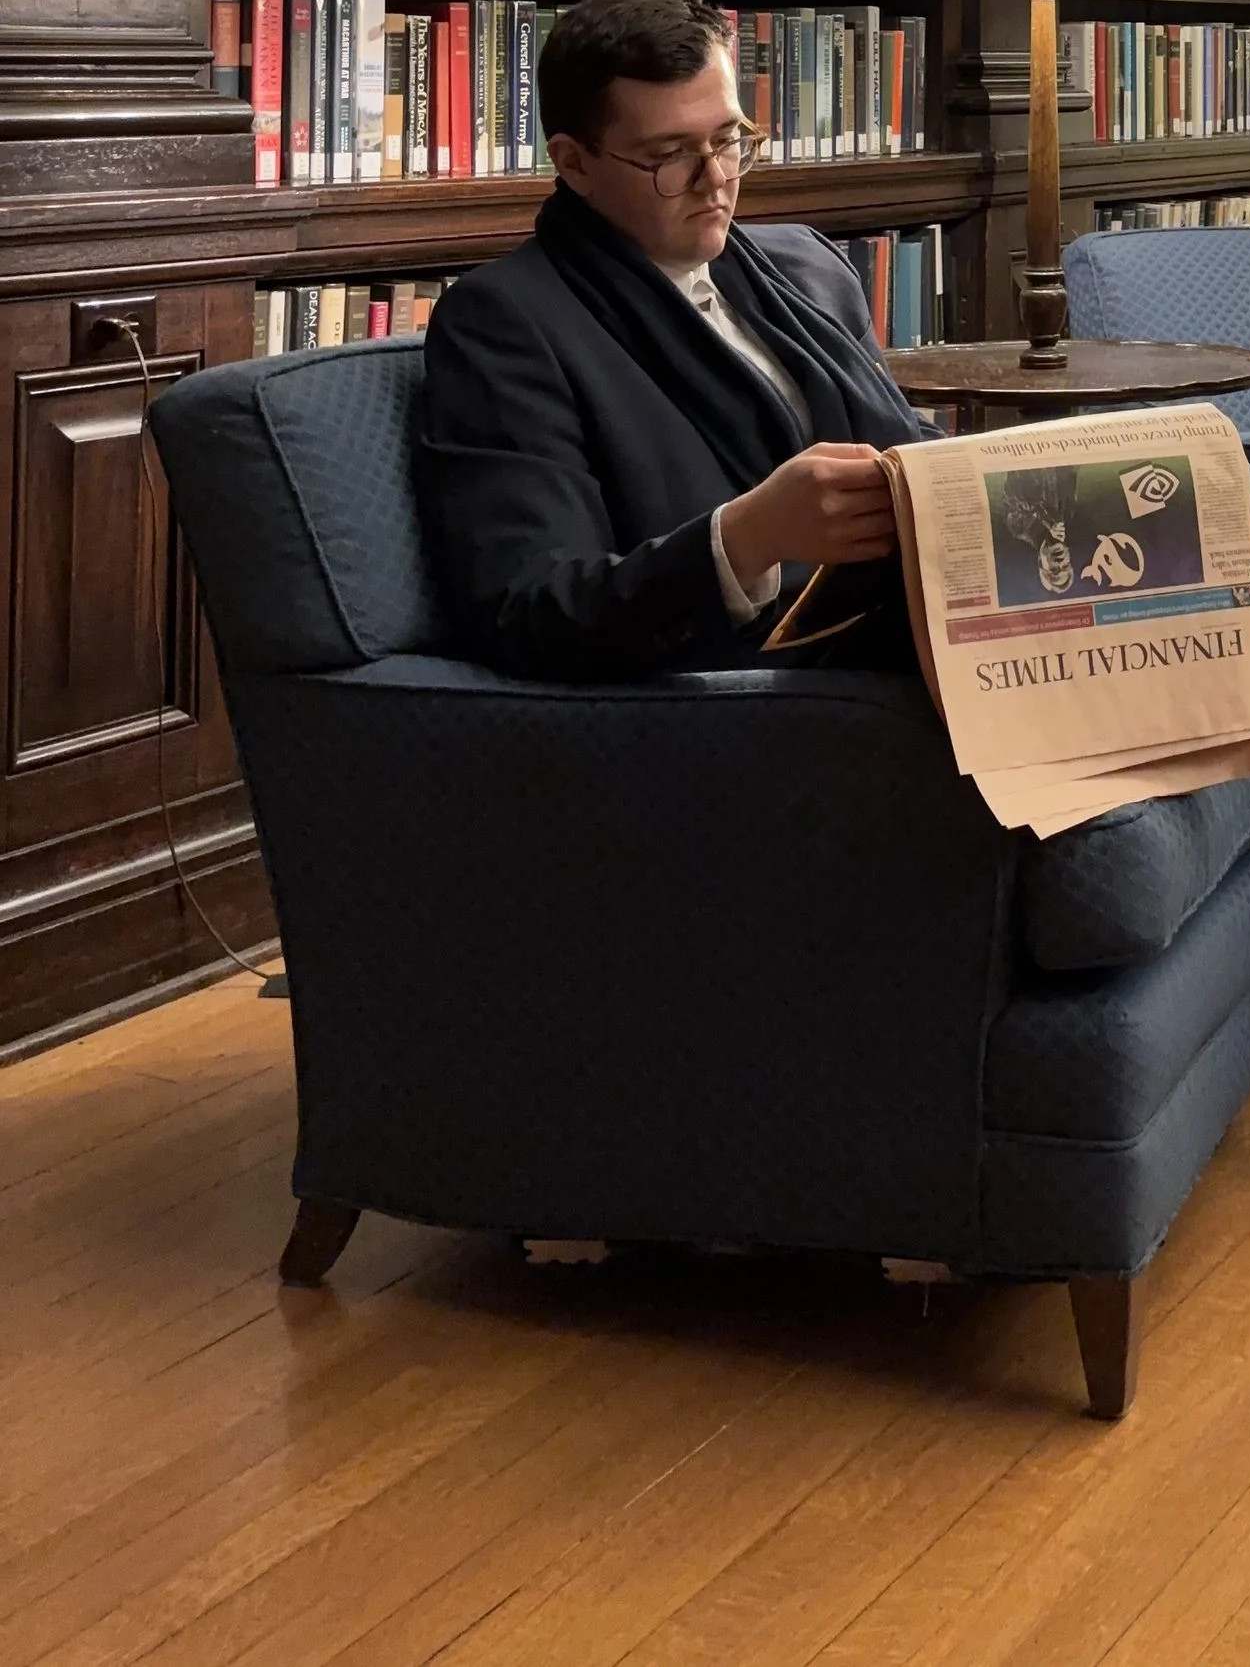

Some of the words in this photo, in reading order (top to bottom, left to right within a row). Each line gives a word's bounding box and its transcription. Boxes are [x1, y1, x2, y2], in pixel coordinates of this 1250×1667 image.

[417, 21, 428, 45] The
[341, 19, 350, 68] MACARTHUR
[519, 22, 531, 69] General
[417, 46, 428, 80] Years
[341, 69, 349, 80] AT
[519, 71, 530, 84] of
[341, 81, 349, 99] WAR
[417, 83, 428, 97] of
[519, 86, 530, 106] the
[417, 99, 427, 147] MacAr
[516, 108, 529, 144] Army
[308, 290, 318, 327] DEAN
[1161, 413, 1208, 426] federal
[1121, 432, 1139, 443] on
[1141, 429, 1183, 442] freeze
[1183, 424, 1232, 438] Trump
[980, 442, 1037, 457] billions
[1037, 441, 1051, 454] of
[1053, 433, 1121, 453] hundreds
[1078, 630, 1245, 676] FINANCIAL
[976, 652, 1073, 692] TIMES
